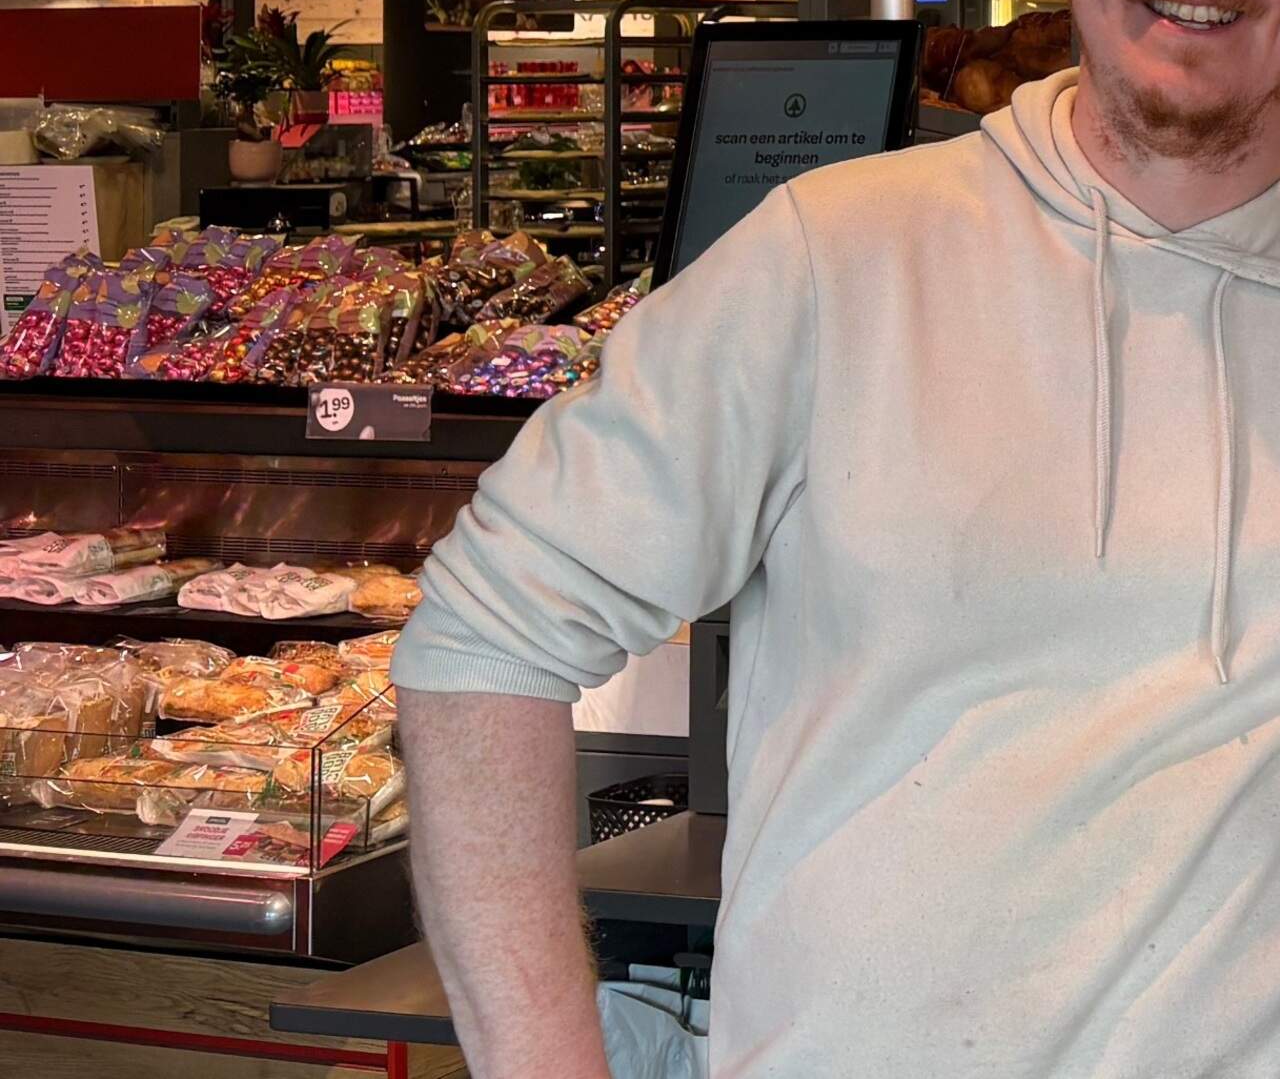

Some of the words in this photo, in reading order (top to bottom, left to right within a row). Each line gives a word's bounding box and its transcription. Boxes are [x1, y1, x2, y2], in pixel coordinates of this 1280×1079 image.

[714, 131, 748, 145] scan
[749, 131, 776, 145] een
[777, 129, 823, 145] artikel
[824, 131, 849, 145] om
[851, 131, 866, 145] te
[754, 151, 819, 168] beginnen
